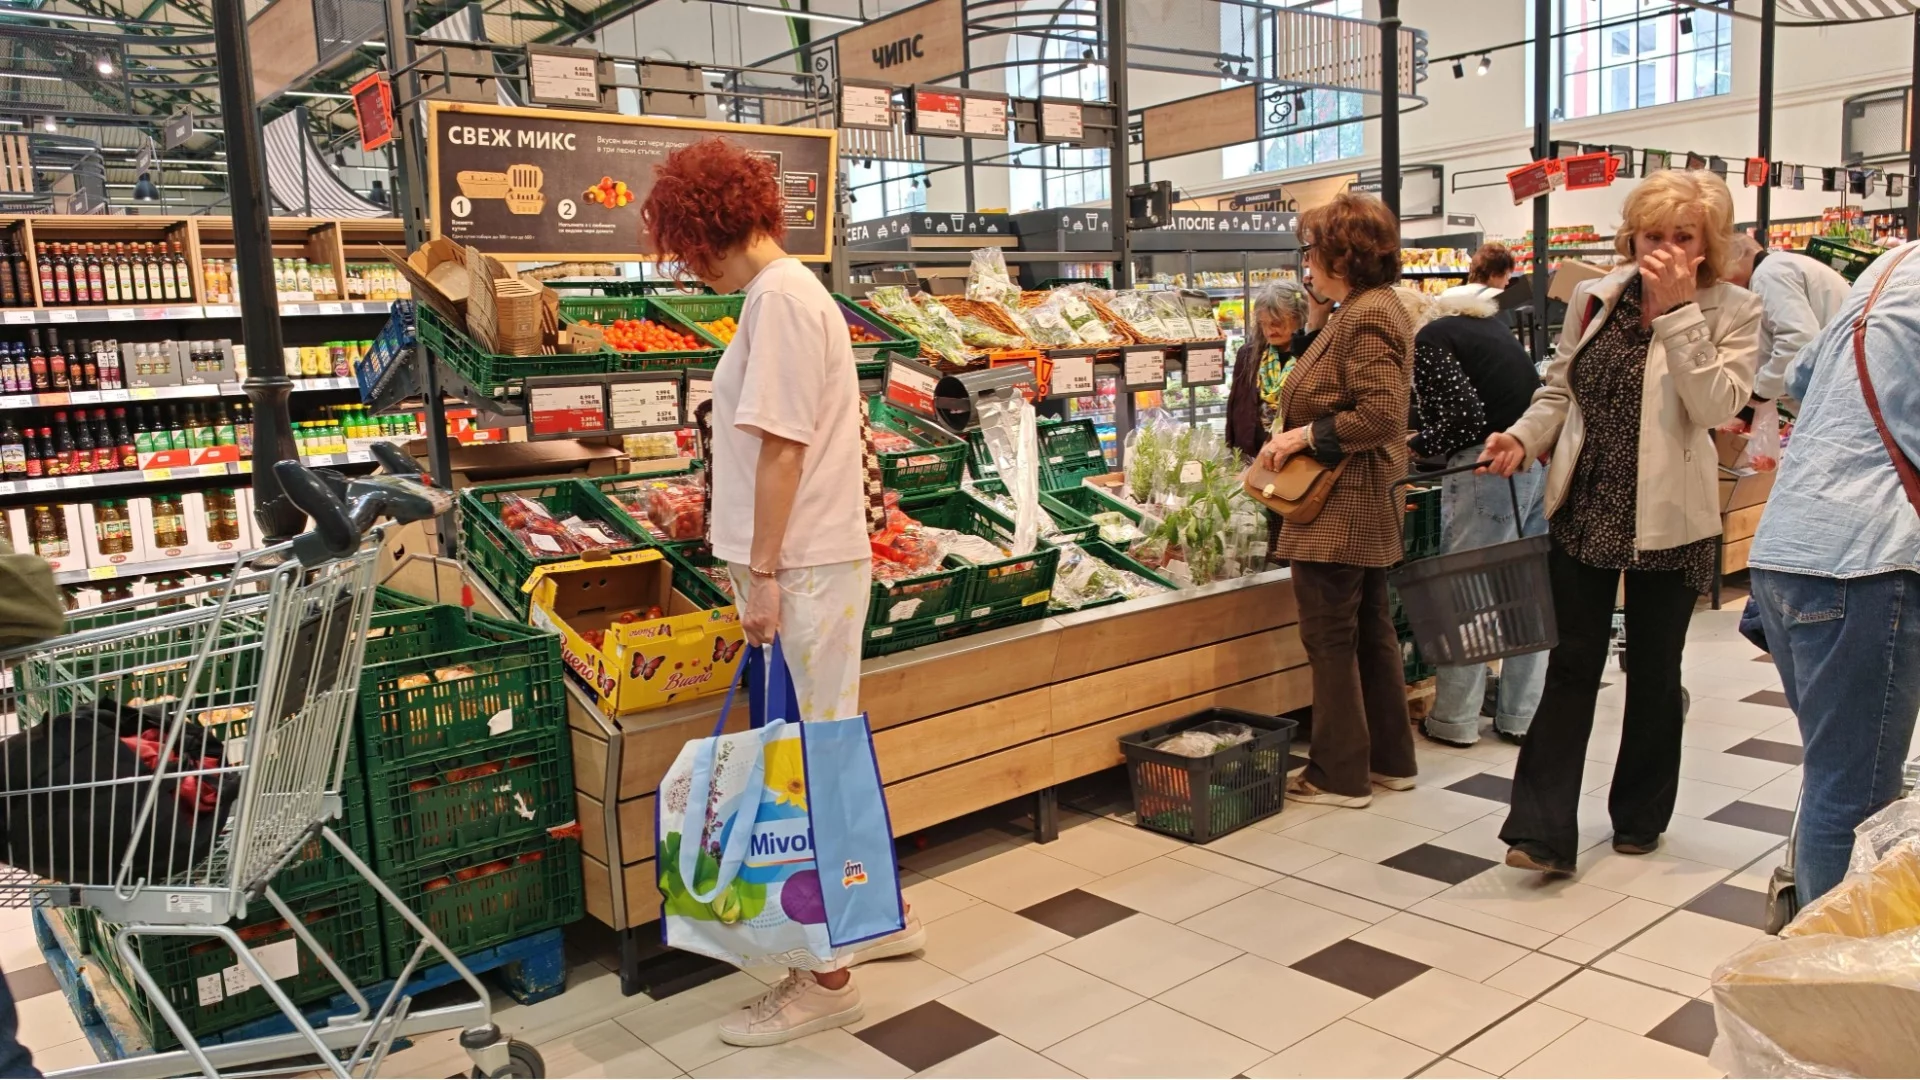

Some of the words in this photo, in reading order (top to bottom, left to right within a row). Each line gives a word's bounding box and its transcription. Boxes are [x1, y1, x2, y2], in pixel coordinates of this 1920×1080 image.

[872, 34, 924, 69] ЧИПС
[448, 125, 512, 148] СВЕЖ
[518, 129, 577, 151] МИКС
[597, 136, 621, 145] Вкусен
[603, 147, 615, 155] три
[456, 200, 464, 214] 1
[563, 202, 572, 216] 2
[1179, 217, 1216, 230] ПОСЛЕ
[847, 225, 869, 242] СЕГА
[629, 627, 657, 638] Bueno
[560, 632, 595, 682] Bueno
[660, 670, 713, 692] Bueno
[845, 861, 862, 877] dm
